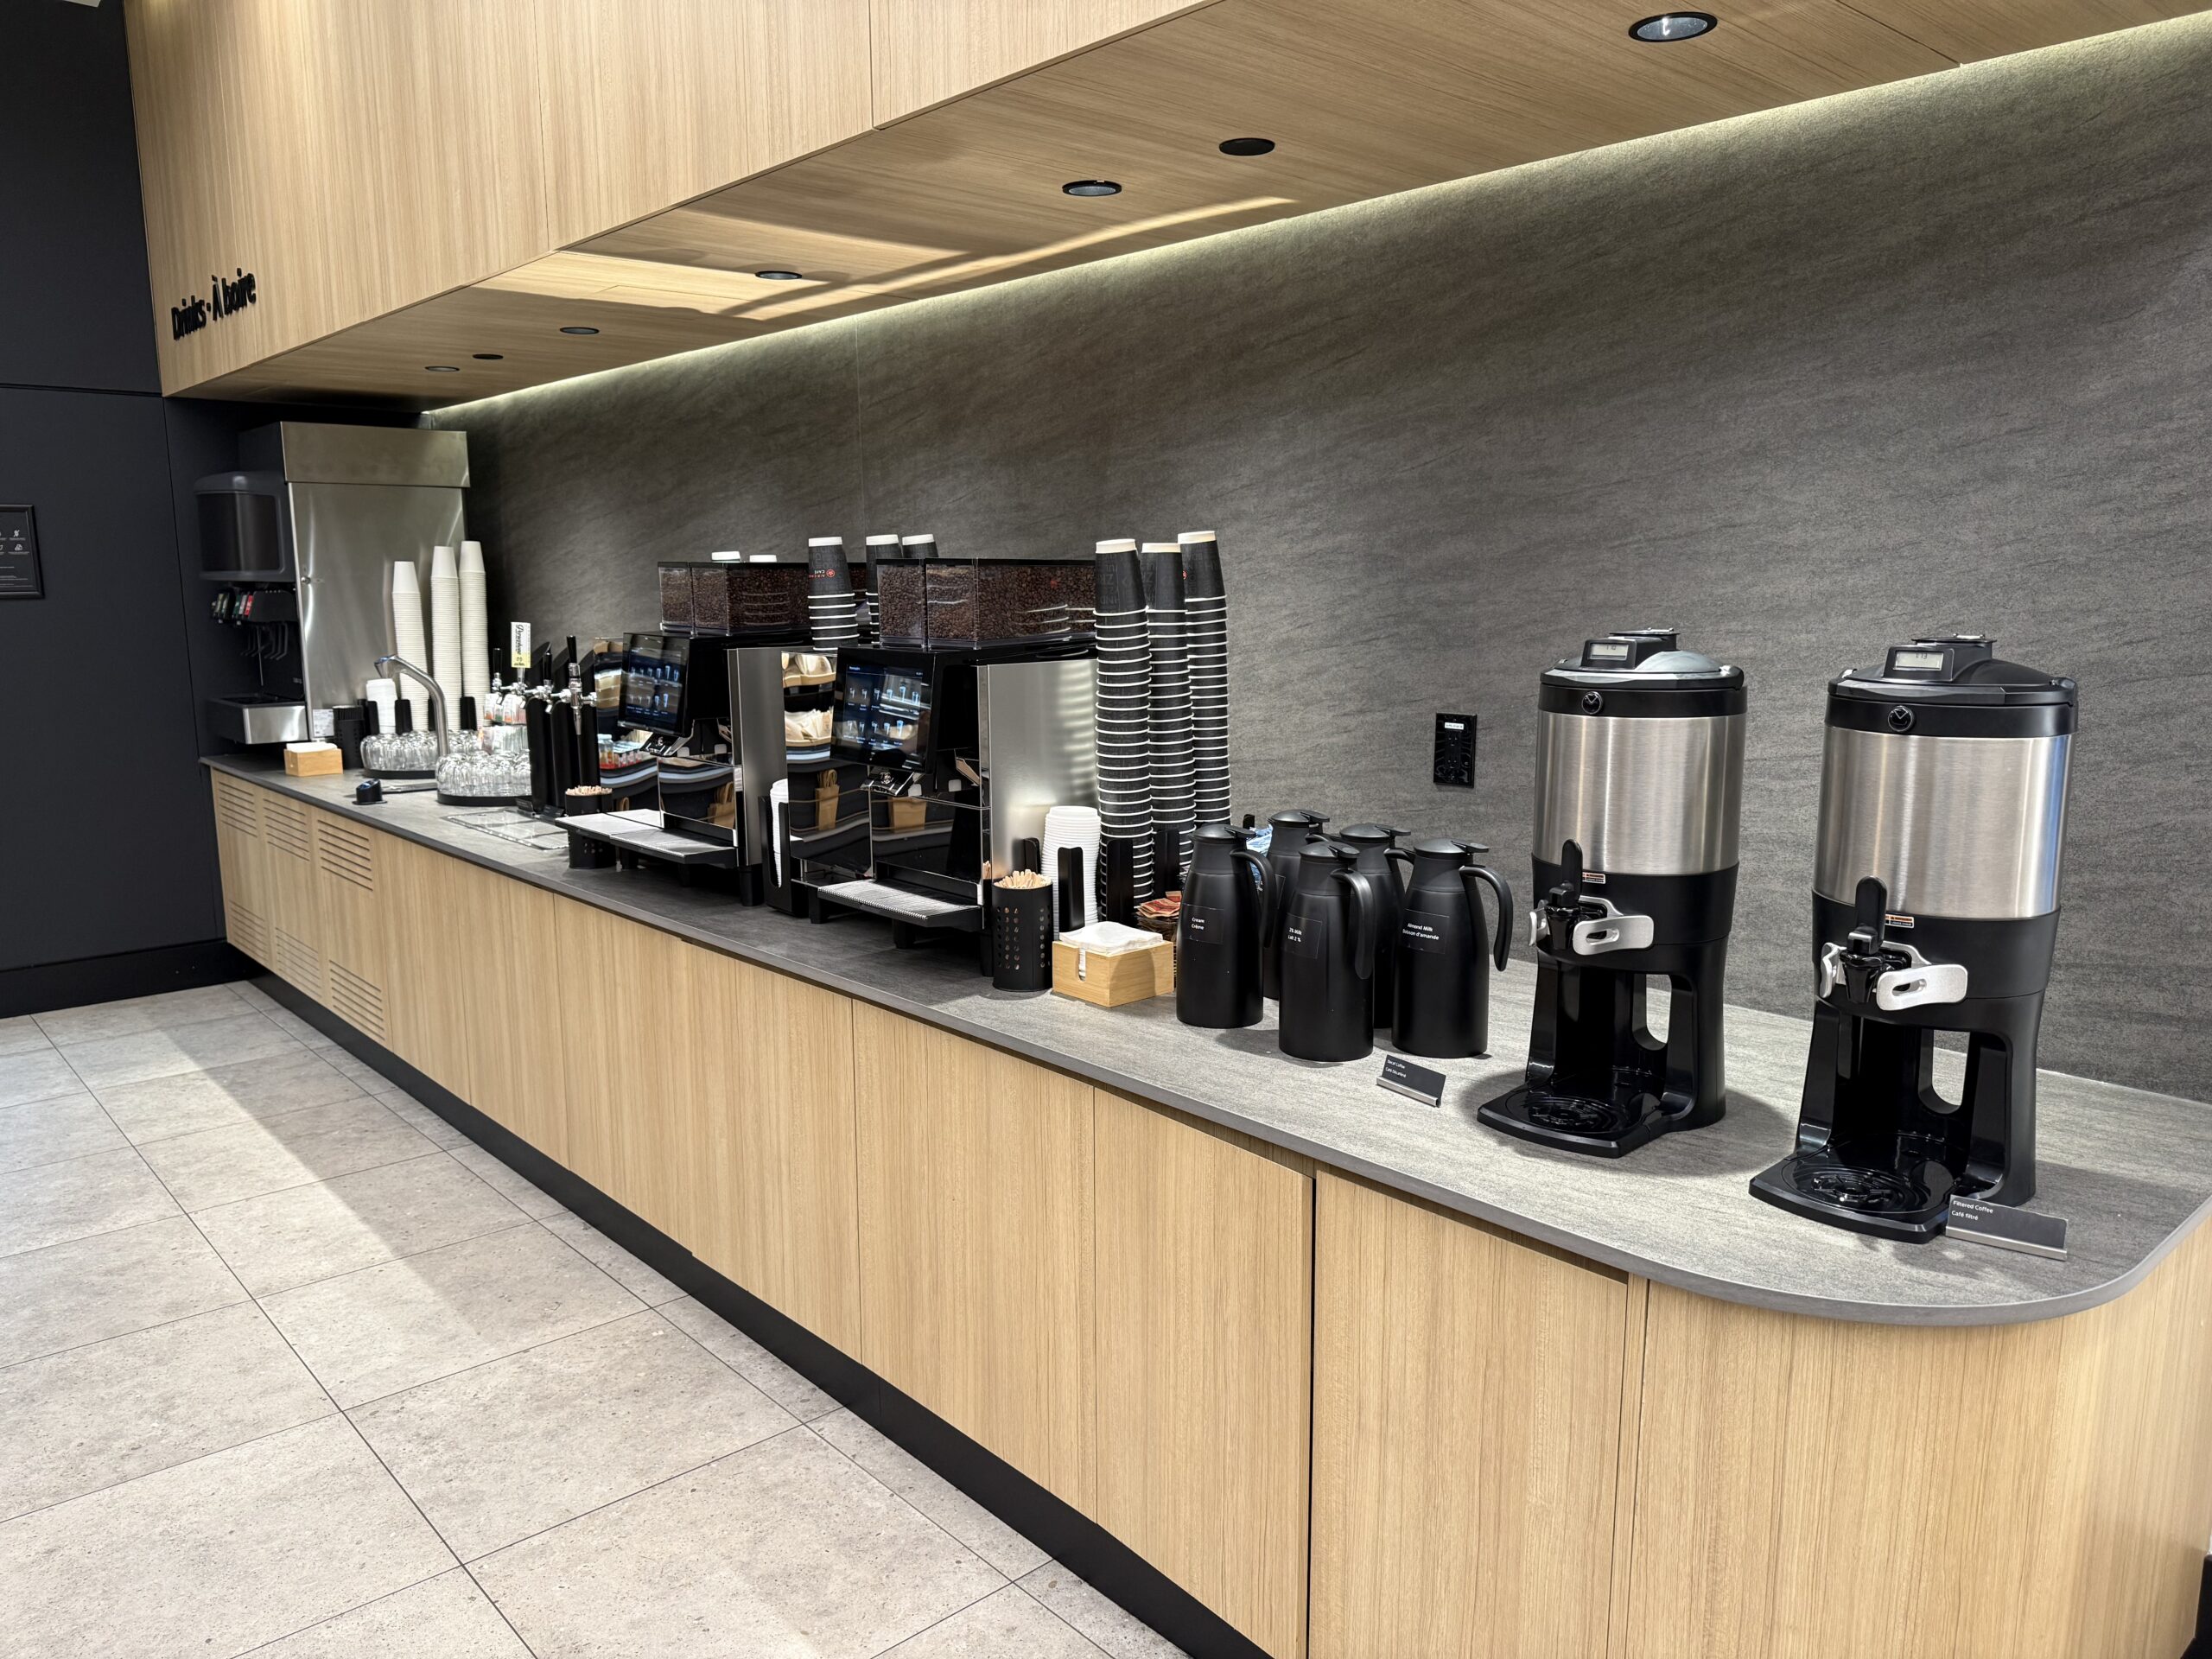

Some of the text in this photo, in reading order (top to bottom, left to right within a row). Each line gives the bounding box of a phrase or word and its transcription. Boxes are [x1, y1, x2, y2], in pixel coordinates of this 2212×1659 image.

[171, 295, 207, 340] Drinks
[212, 275, 224, 321] À
[221, 268, 257, 315] boire
[1951, 1210, 1965, 1218] Café
[1953, 1200, 1993, 1214] Filtered Coffee
